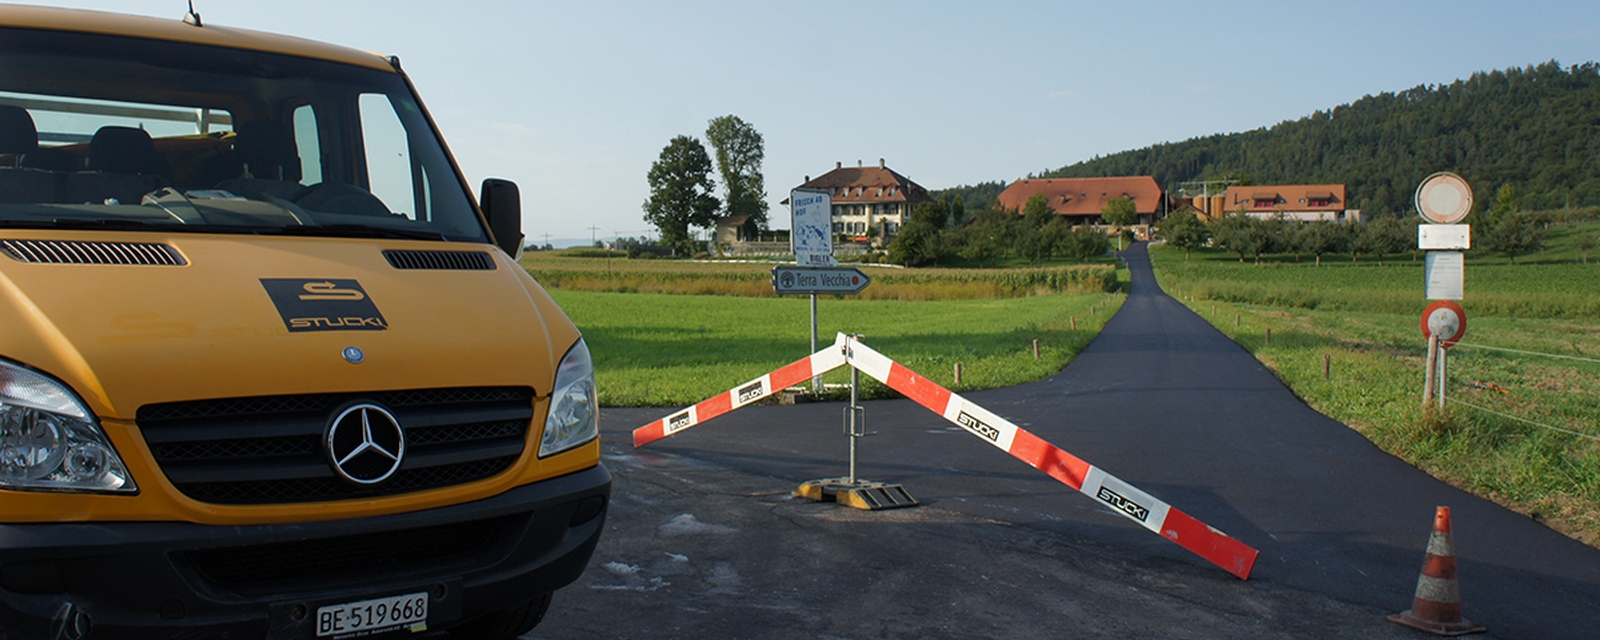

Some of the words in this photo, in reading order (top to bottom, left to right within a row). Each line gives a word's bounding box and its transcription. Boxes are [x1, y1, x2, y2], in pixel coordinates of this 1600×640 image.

[795, 197, 814, 207] FRISCH
[815, 195, 823, 204] AB
[795, 208, 806, 216] HOF
[796, 273, 817, 287] Terra
[820, 273, 851, 287] Vecchia
[289, 316, 383, 328] STUCKI
[958, 411, 999, 441] STUCKI
[1099, 487, 1148, 521] STUCKI
